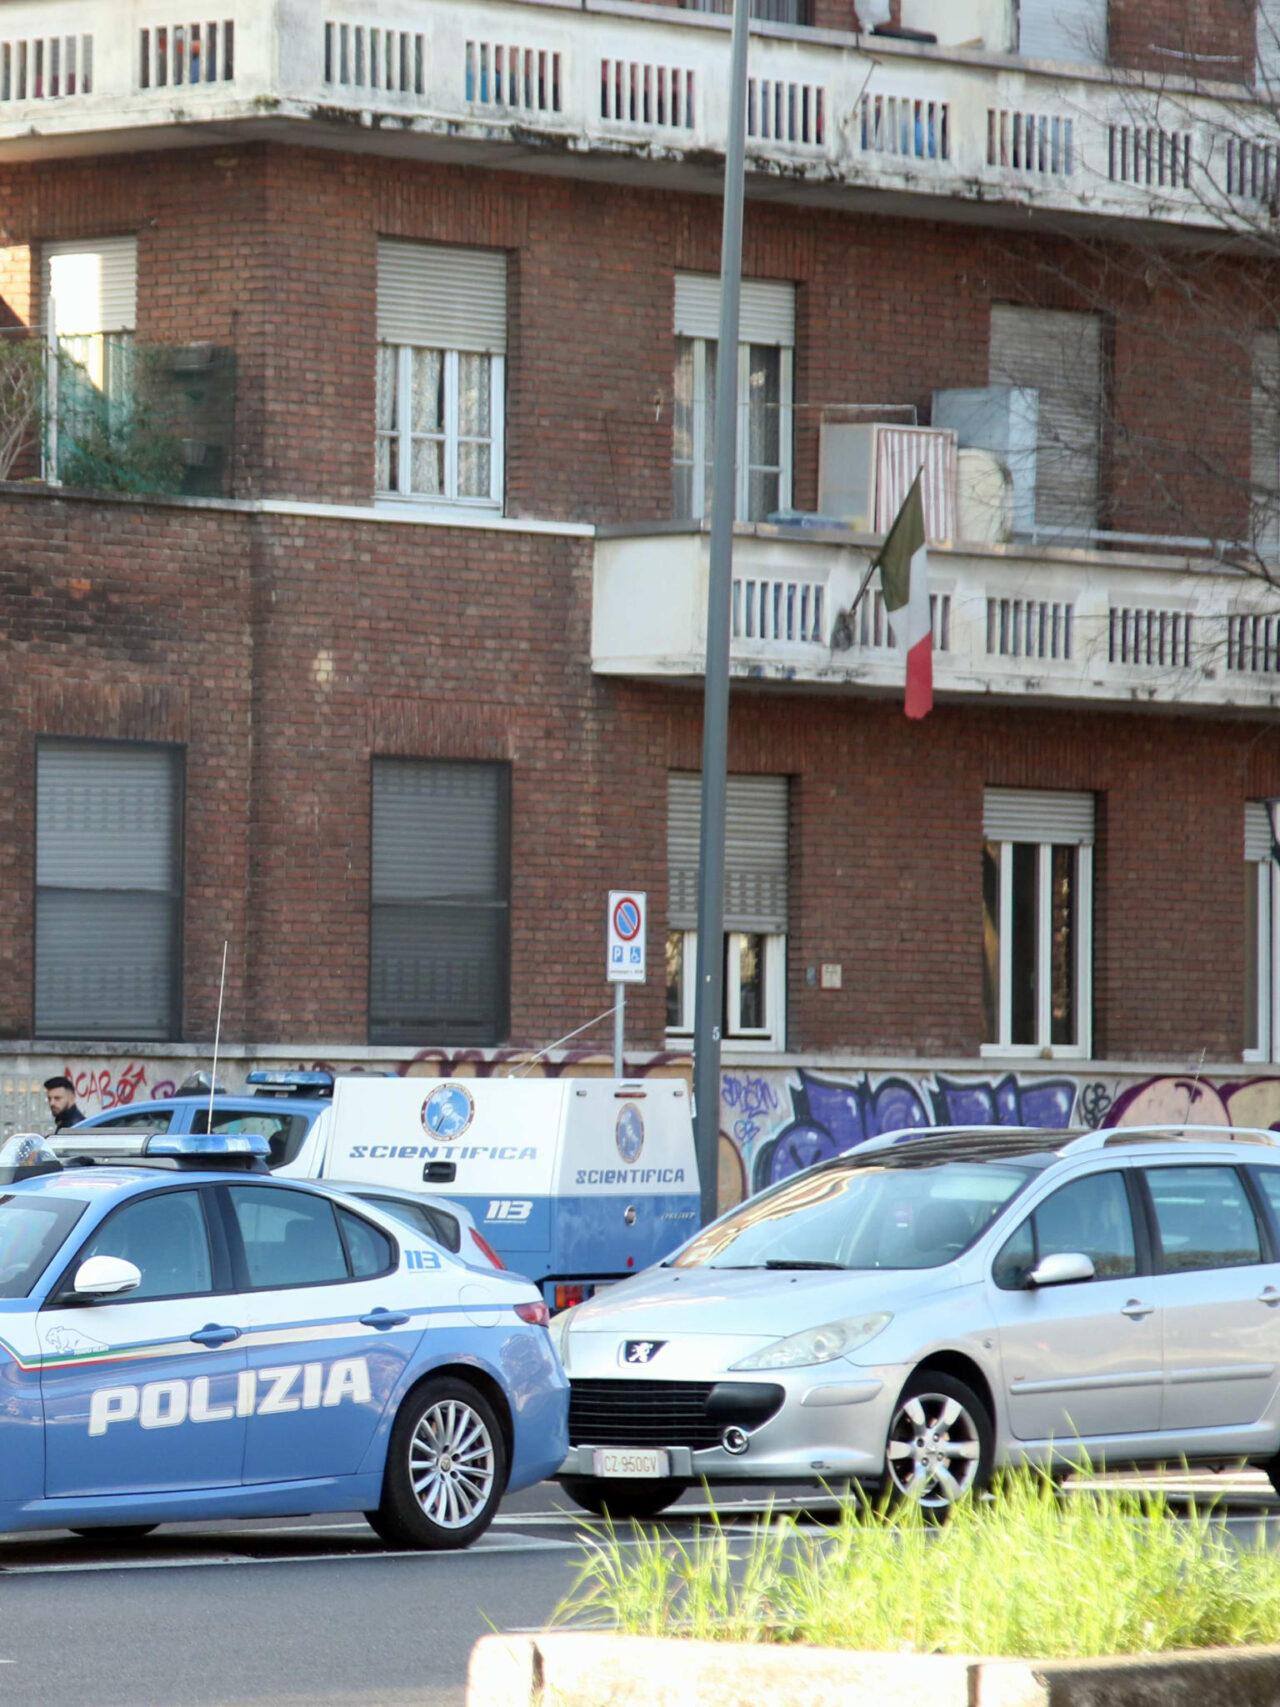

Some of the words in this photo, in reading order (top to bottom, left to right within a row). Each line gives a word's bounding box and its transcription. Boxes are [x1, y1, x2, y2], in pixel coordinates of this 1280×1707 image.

[349, 1145, 538, 1160] SCIENTIFICA
[575, 1168, 686, 1184] SCIENTIFICA
[486, 1200, 534, 1220] 113
[404, 1250, 442, 1269] 113
[88, 1356, 372, 1437] POLIZIA
